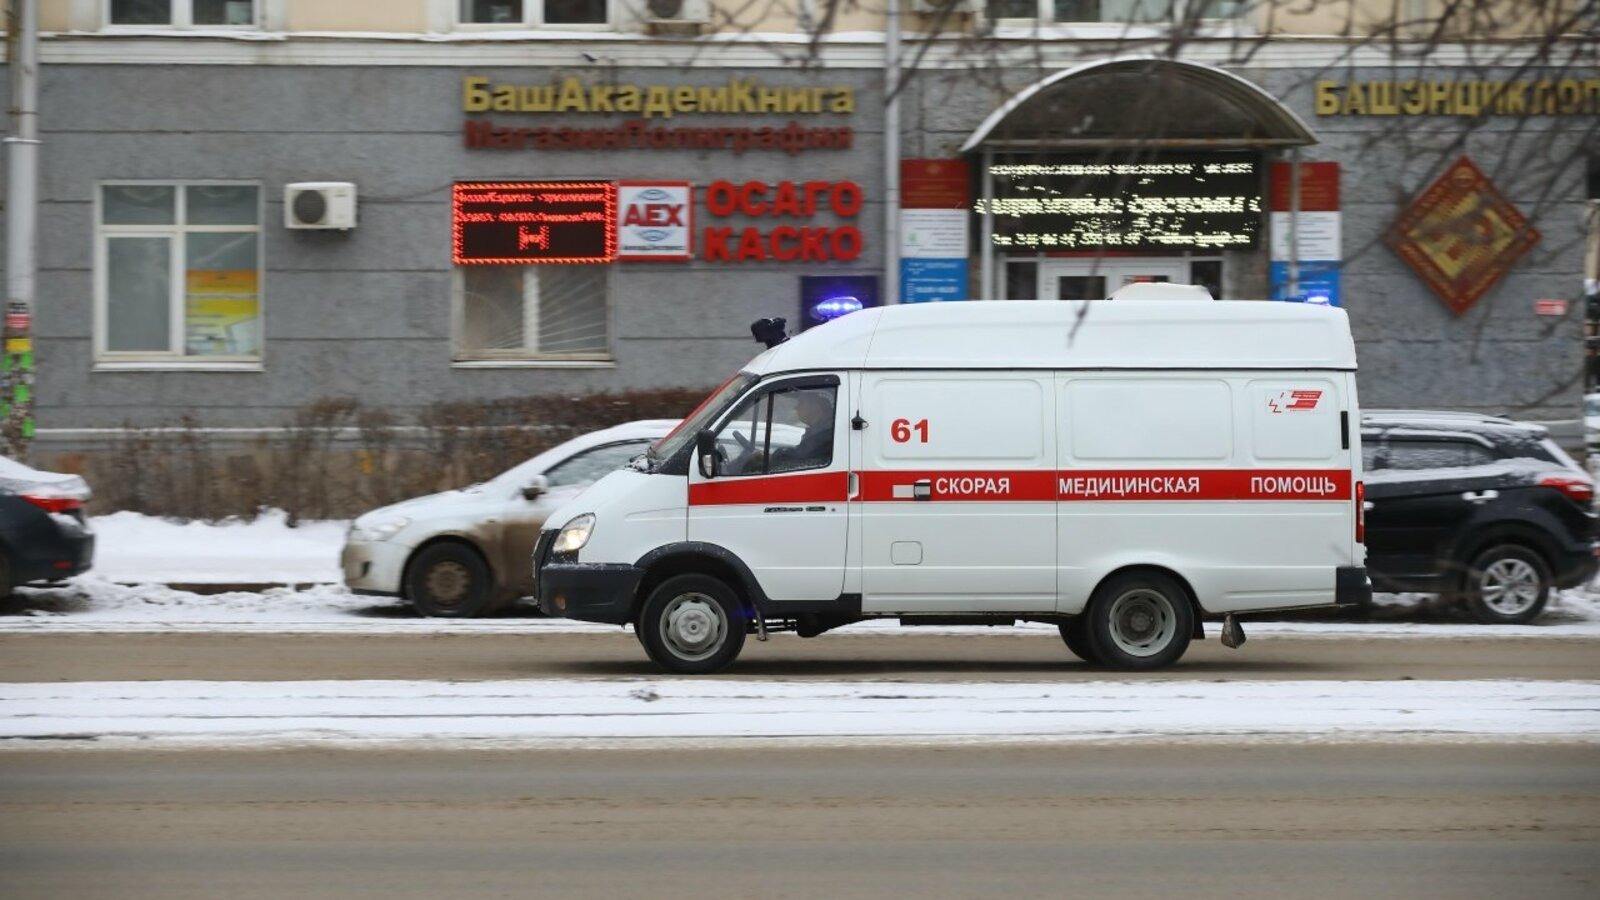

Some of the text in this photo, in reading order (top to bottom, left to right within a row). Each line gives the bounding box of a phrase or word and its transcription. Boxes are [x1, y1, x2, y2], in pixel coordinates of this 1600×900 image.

[706, 180, 863, 217] ОСАГО
[705, 226, 863, 262] КАСКО
[891, 418, 929, 443] 61
[935, 476, 1337, 496] СКОРАЯ МЕДИЦИНСКАЯ ПОМОЩЬ
